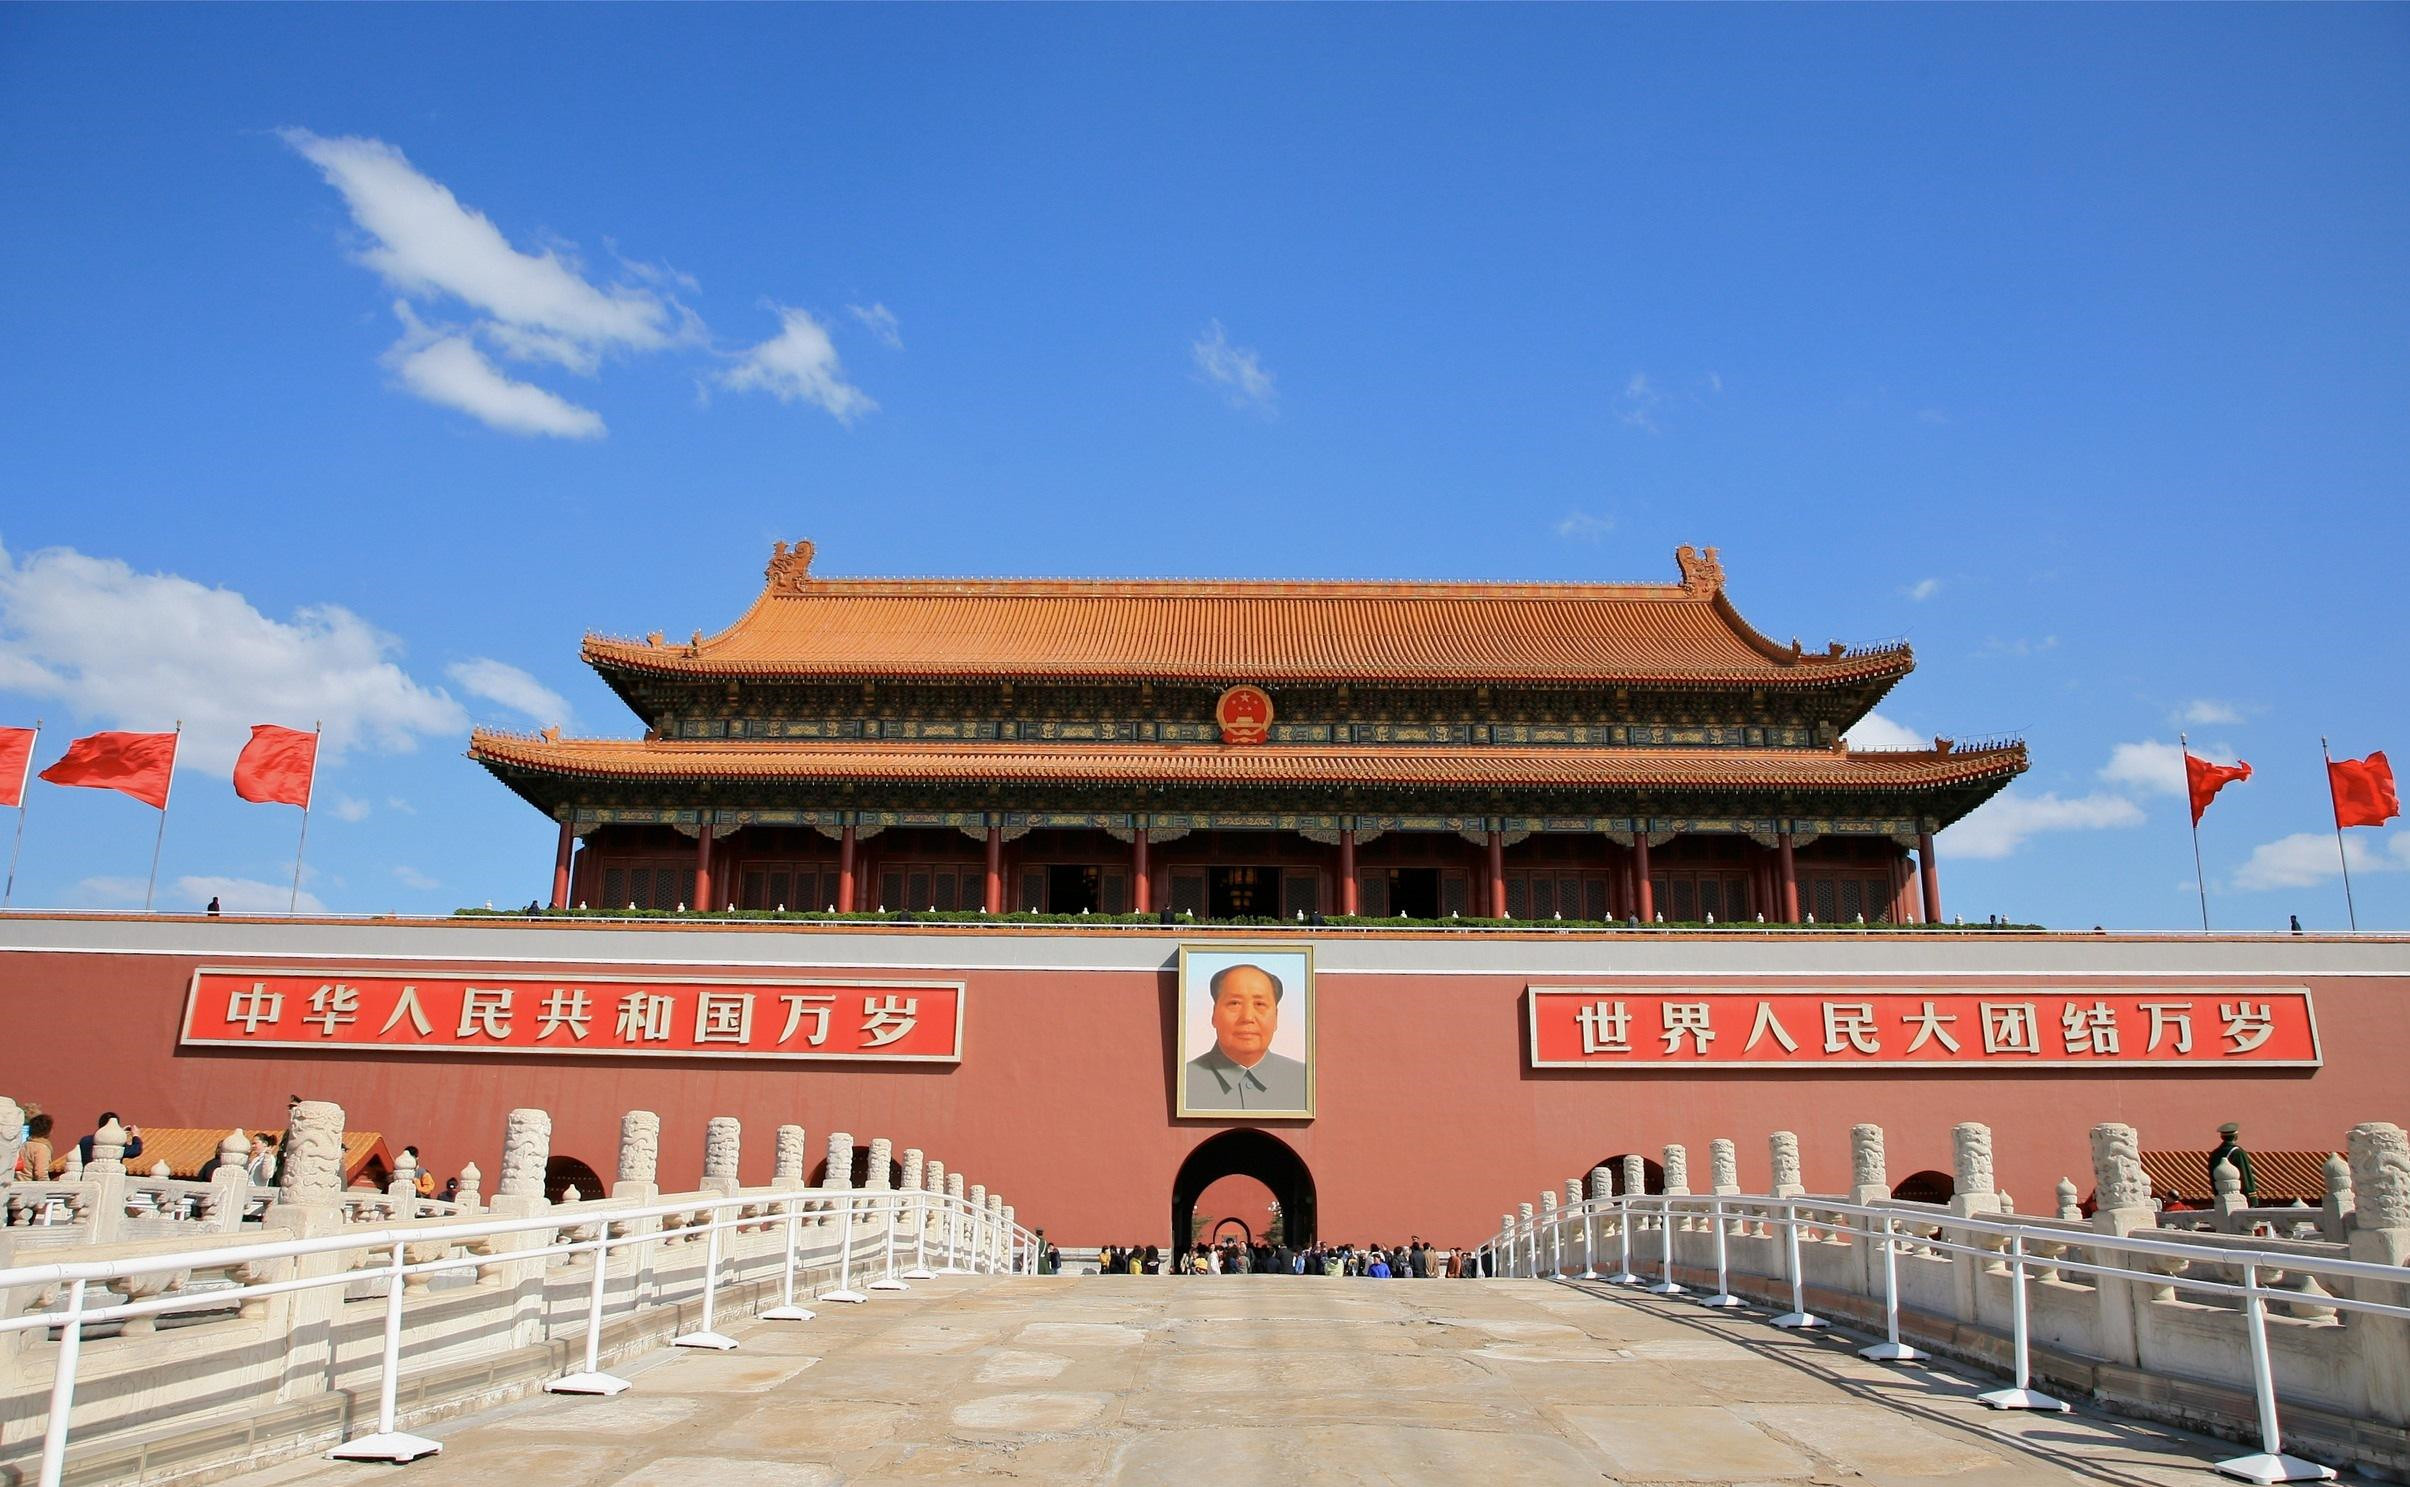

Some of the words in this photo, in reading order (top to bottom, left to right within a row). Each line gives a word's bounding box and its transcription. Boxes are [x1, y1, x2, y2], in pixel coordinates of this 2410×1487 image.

[226, 983, 919, 1047] 中华人民共和国万岁
[1575, 1001, 2276, 1054] 世界人民大团结万岁
